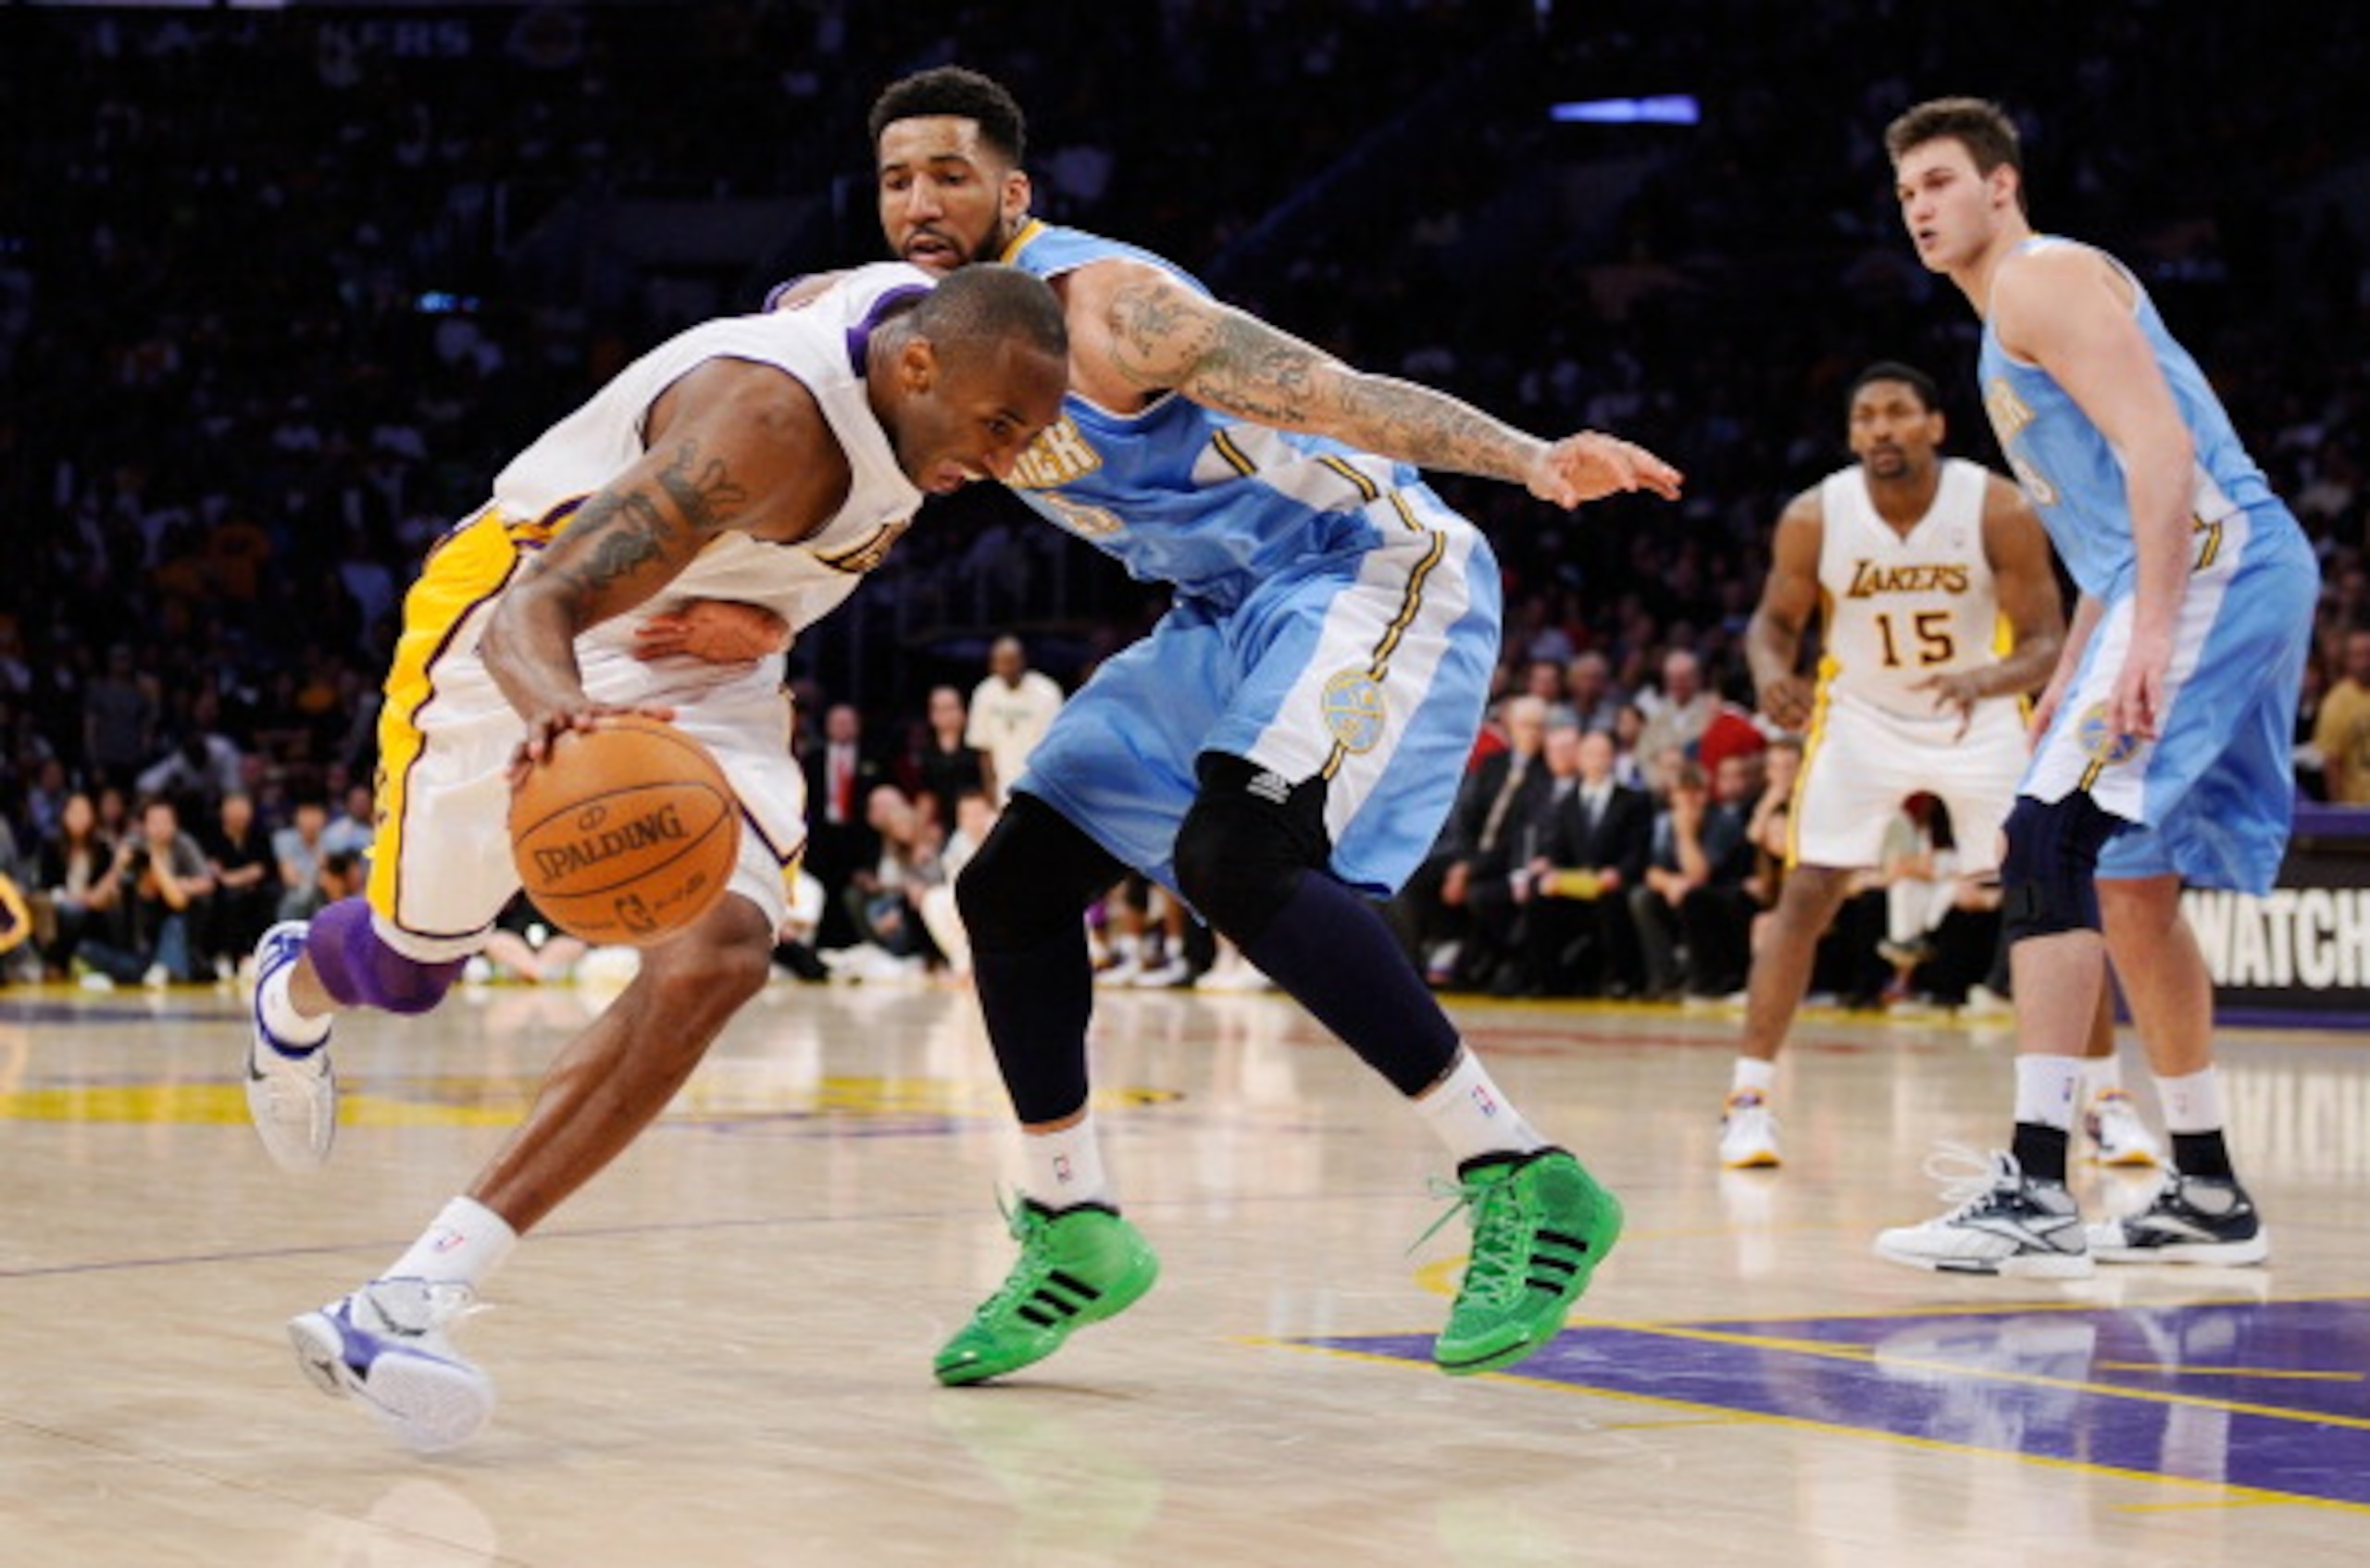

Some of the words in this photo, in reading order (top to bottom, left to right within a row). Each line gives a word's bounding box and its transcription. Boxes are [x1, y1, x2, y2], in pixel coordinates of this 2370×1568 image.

[1846, 559, 1969, 597] LAKERS
[1876, 612, 1954, 668] 15
[534, 804, 689, 883] SPALDING
[2181, 888, 2370, 989] WATCH
